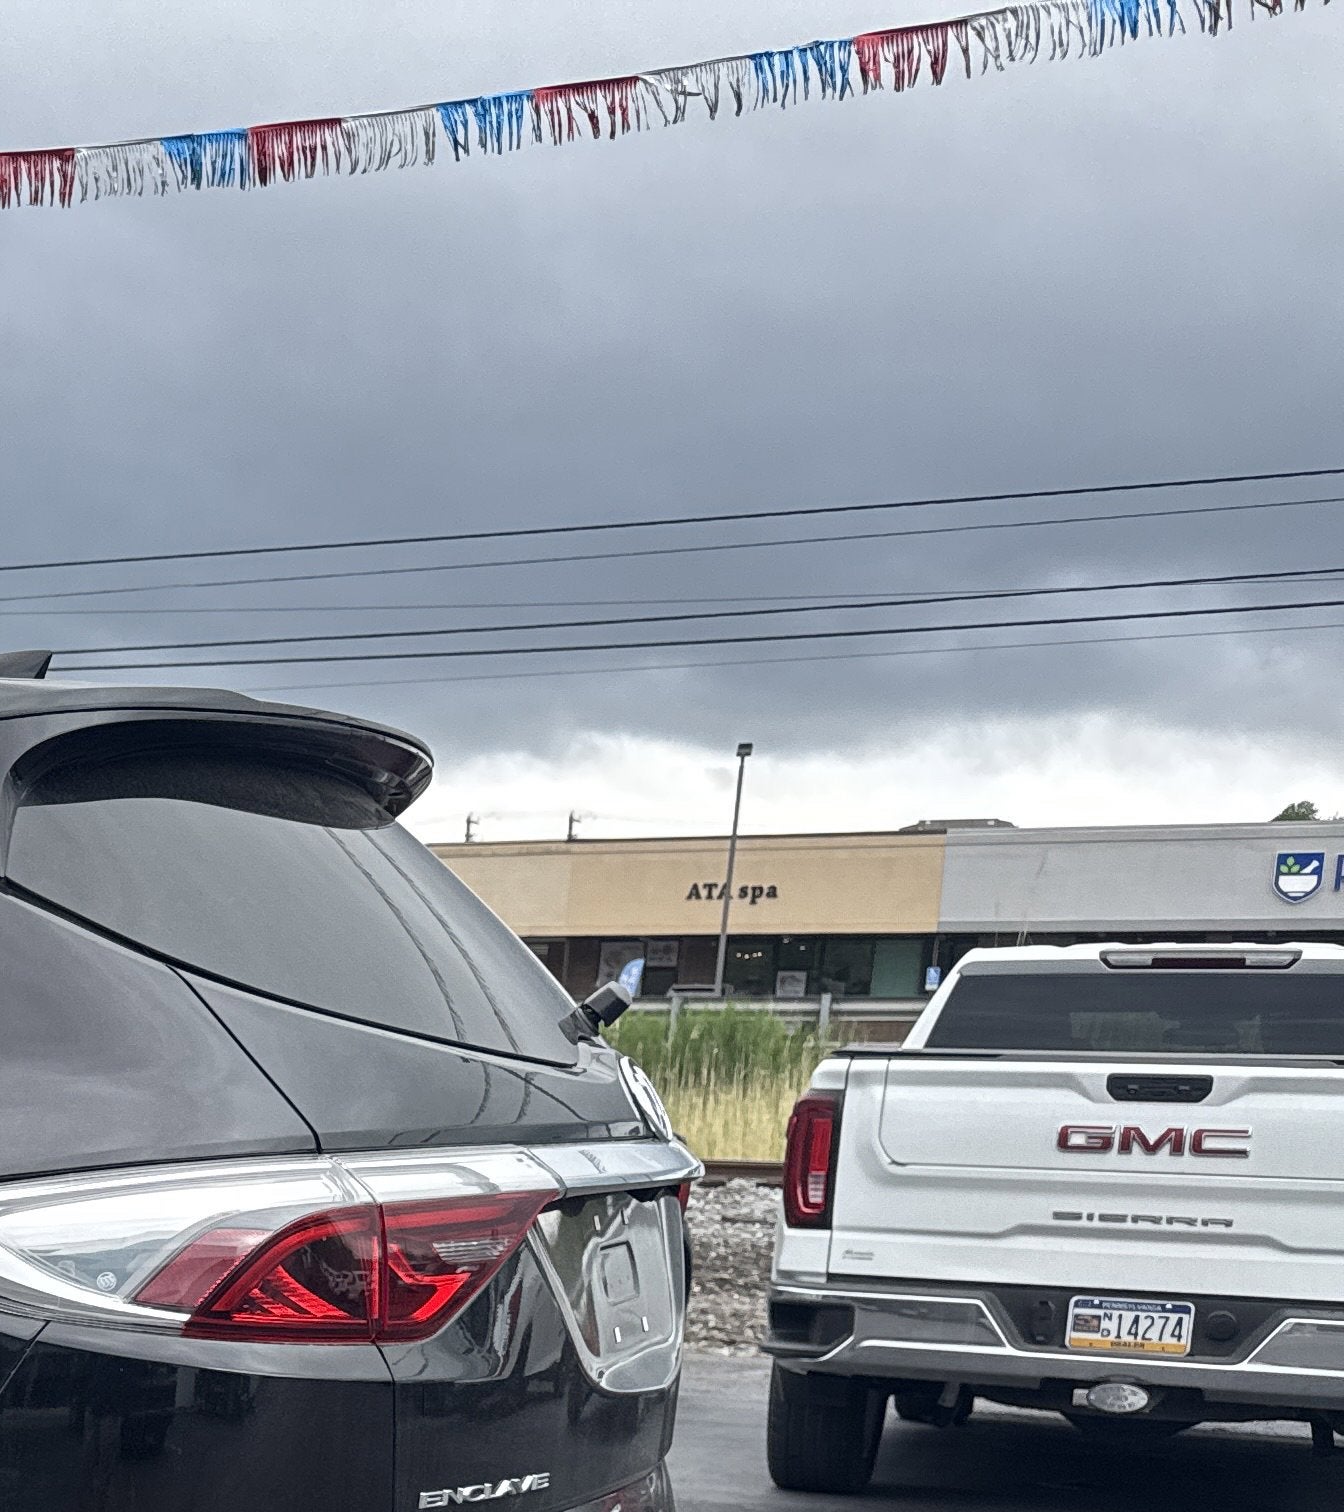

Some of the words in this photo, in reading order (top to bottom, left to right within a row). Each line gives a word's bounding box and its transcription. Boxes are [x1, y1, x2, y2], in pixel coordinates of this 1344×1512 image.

[738, 885, 778, 905] spa
[1057, 1124, 1252, 1159] GMC
[1052, 1211, 1234, 1228] SIERRA
[1101, 1301, 1163, 1312] PENNSYLVANIA
[1114, 1313, 1184, 1342] 14274
[418, 1472, 551, 1509] ENCLAVE
